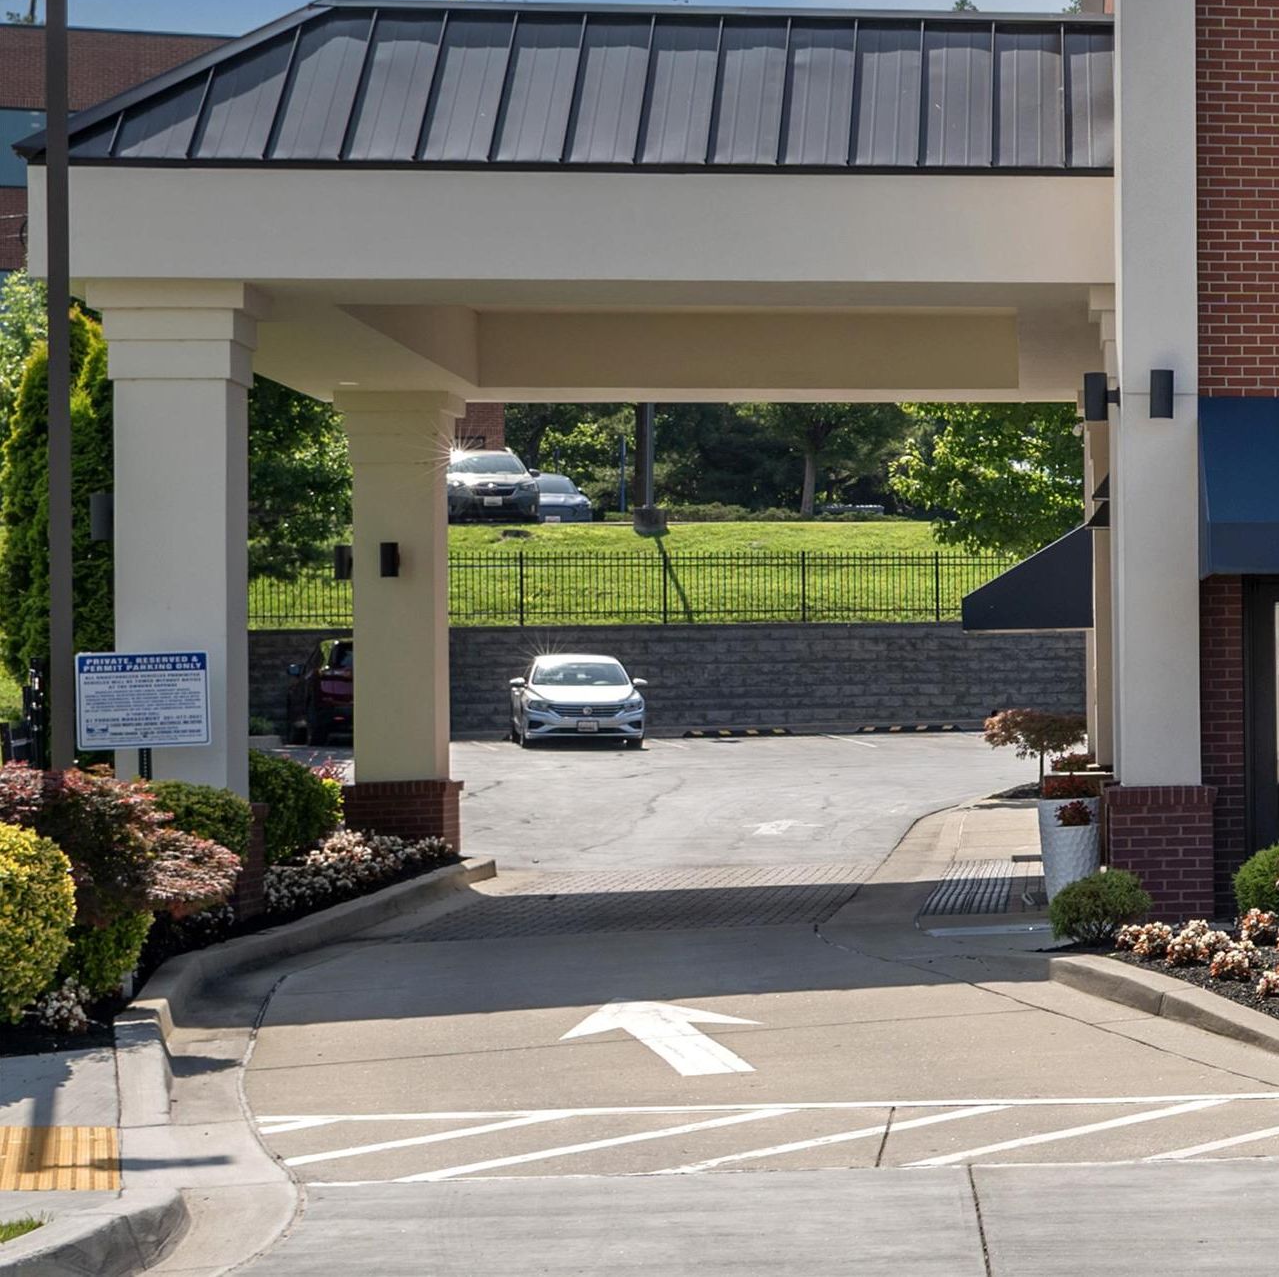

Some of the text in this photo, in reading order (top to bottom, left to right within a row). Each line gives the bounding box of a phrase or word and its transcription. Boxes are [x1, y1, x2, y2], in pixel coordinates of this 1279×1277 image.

[136, 655, 189, 664] RESERVED
[191, 655, 199, 663] &
[83, 662, 202, 673] PERMIT PARKING ONLY
